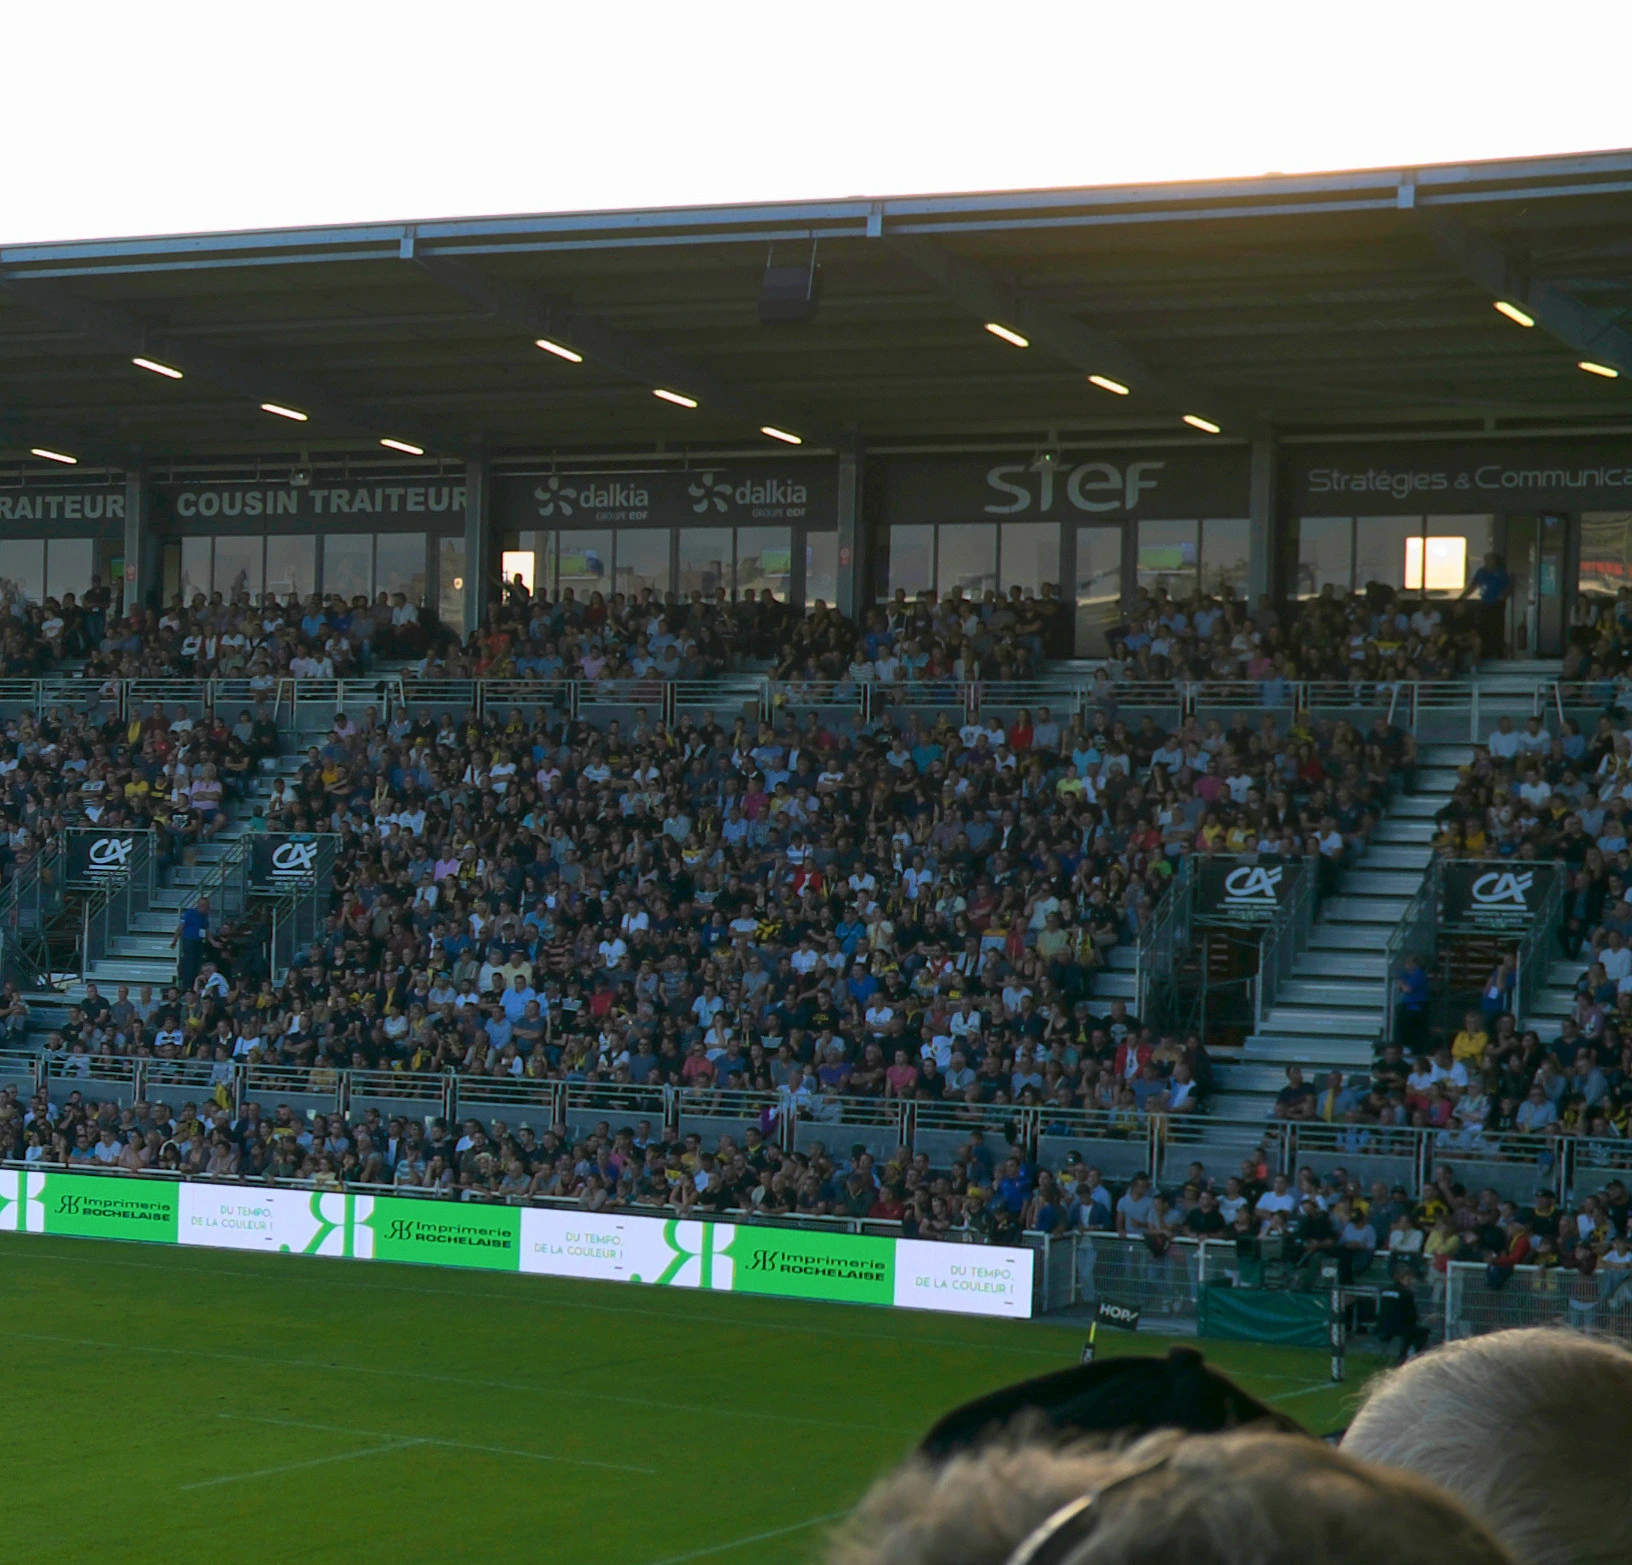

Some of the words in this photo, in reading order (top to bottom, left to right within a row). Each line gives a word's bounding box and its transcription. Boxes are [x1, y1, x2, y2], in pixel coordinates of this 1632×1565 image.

[1454, 471, 1470, 489] &
[579, 483, 648, 508] dalkia
[736, 479, 807, 505] dalkia
[176, 490, 298, 517] COUSIN
[84, 1196, 171, 1211] Imprimerie
[82, 1208, 171, 1222] ROCHELAISE
[416, 1221, 512, 1237] Imprimerie
[565, 1231, 580, 1242] DU
[415, 1233, 512, 1248] ROCHELAISE
[534, 1242, 549, 1253] DE
[550, 1244, 563, 1254] LA
[567, 1246, 617, 1259] COULEUR
[781, 1252, 886, 1269] Imprimerie
[780, 1264, 885, 1281] ROCHELAISE
[950, 1265, 966, 1276] DU
[915, 1276, 930, 1287] DE
[933, 1278, 948, 1289] LA
[951, 1280, 1006, 1294] COULEUR
[1099, 1302, 1139, 1322] HOP!
